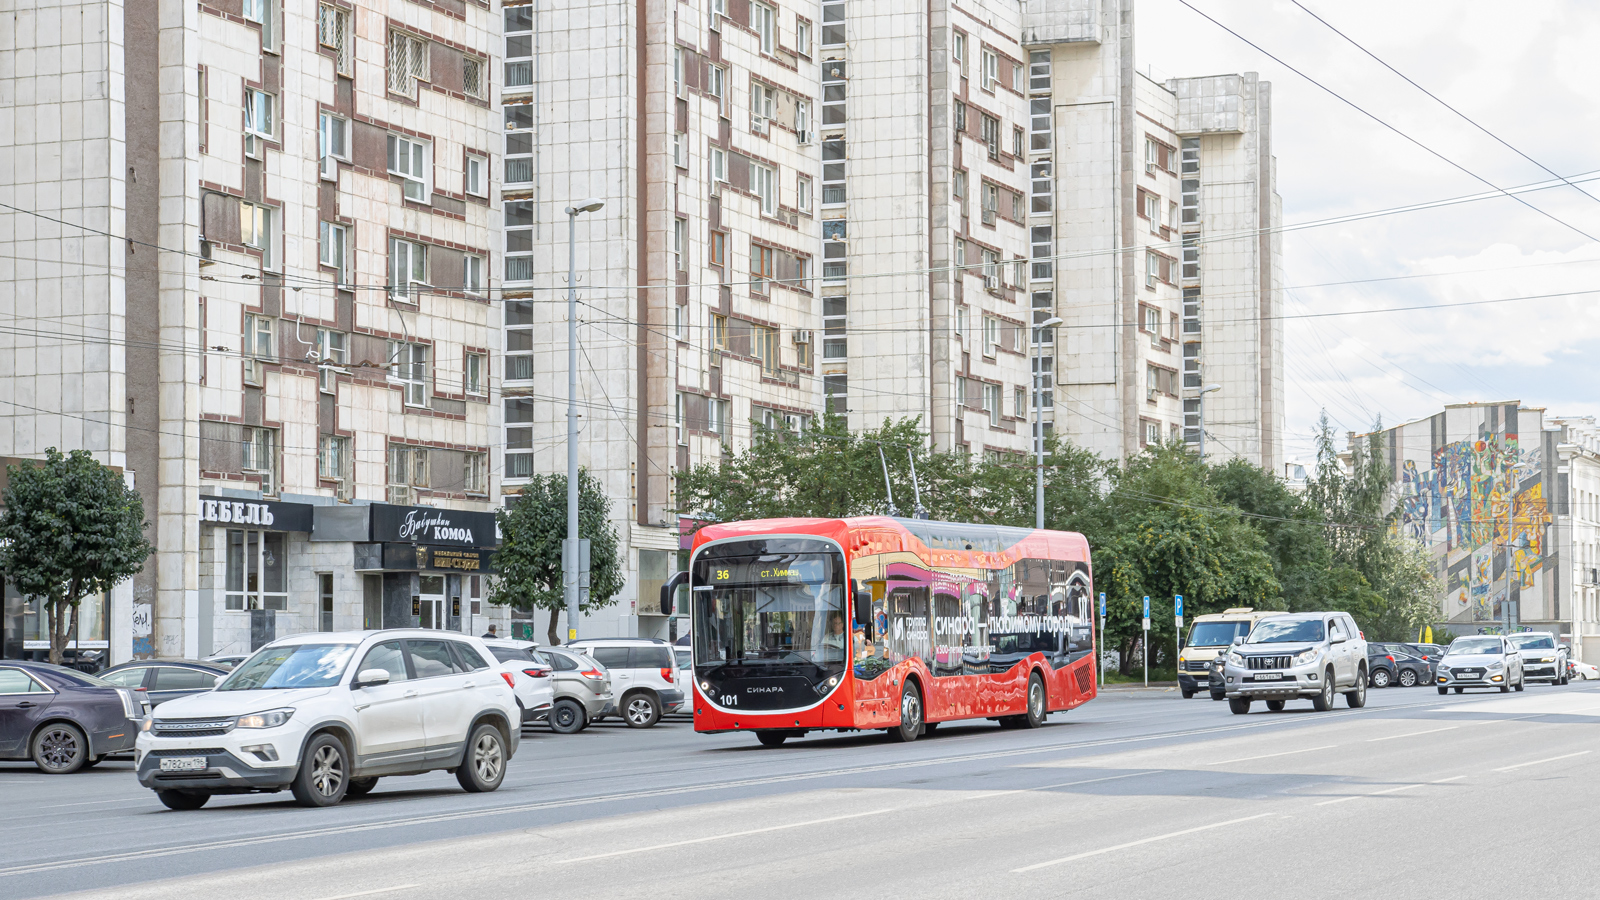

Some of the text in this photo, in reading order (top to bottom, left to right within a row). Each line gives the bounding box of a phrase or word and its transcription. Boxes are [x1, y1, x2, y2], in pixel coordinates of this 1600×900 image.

[399, 510, 450, 538] Бабушкин
[434, 527, 473, 543] КОМОД
[716, 570, 729, 579] 36
[905, 617, 926, 629] группа
[935, 617, 975, 639] синара
[989, 614, 1041, 638] любимому
[1043, 616, 1074, 637] городу
[907, 631, 928, 642] синара
[747, 686, 784, 694] СИНАРА
[720, 695, 738, 705] 101
